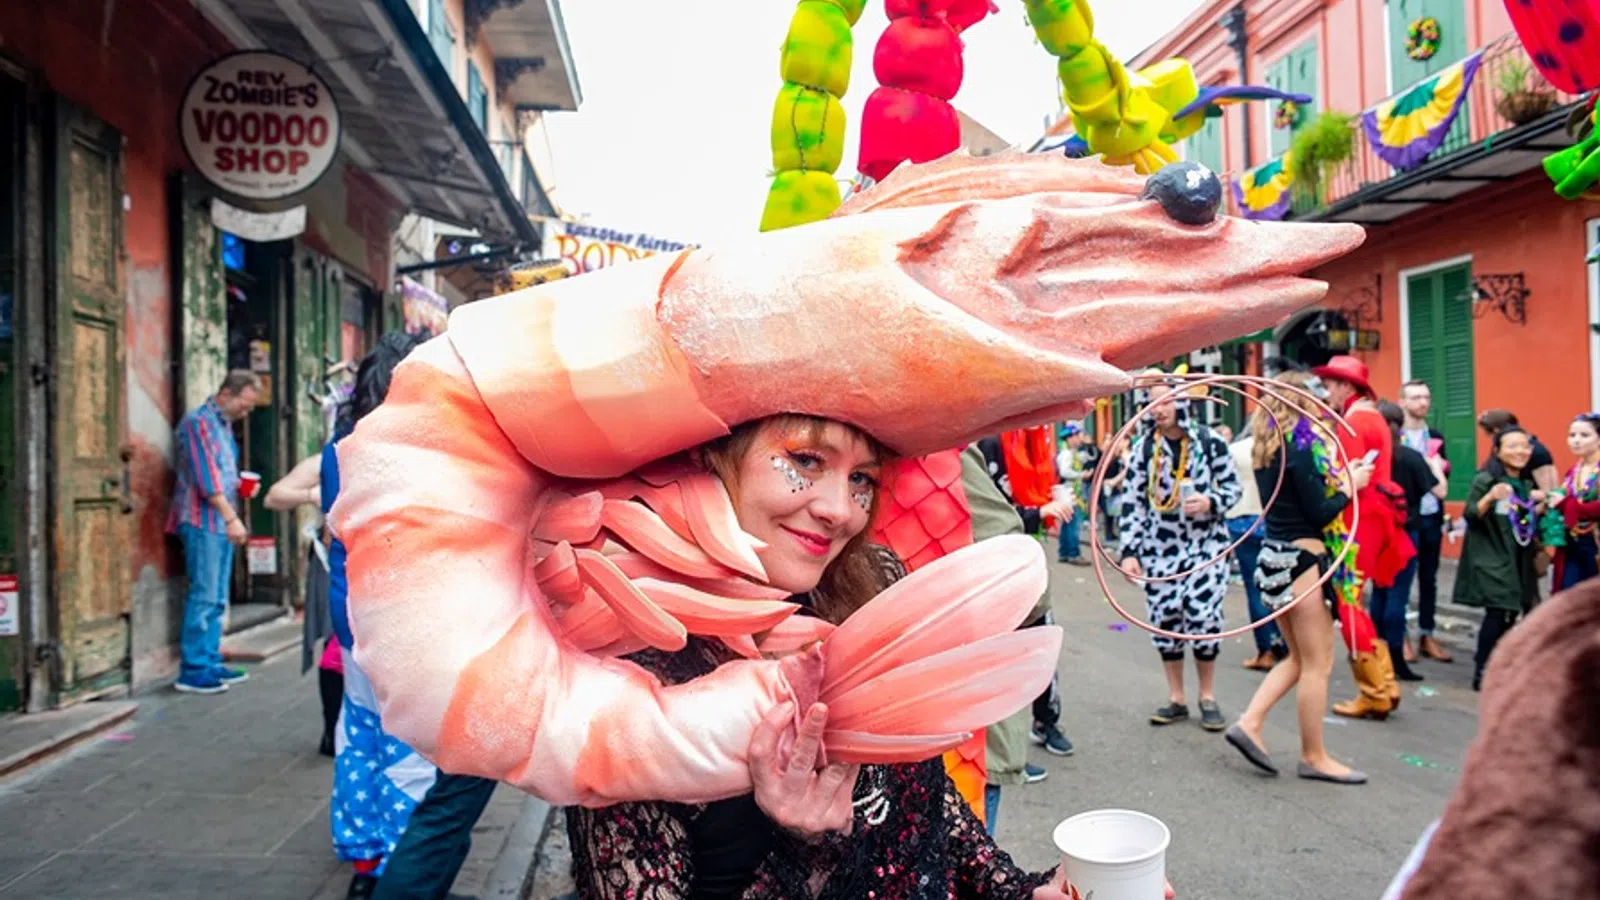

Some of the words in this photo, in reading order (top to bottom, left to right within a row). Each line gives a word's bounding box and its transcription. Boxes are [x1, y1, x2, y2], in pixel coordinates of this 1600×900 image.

[203, 76, 318, 108] ZOMBIE'S
[237, 71, 288, 86] REV.
[192, 108, 328, 147] VOODOO
[215, 147, 309, 175] SHOP
